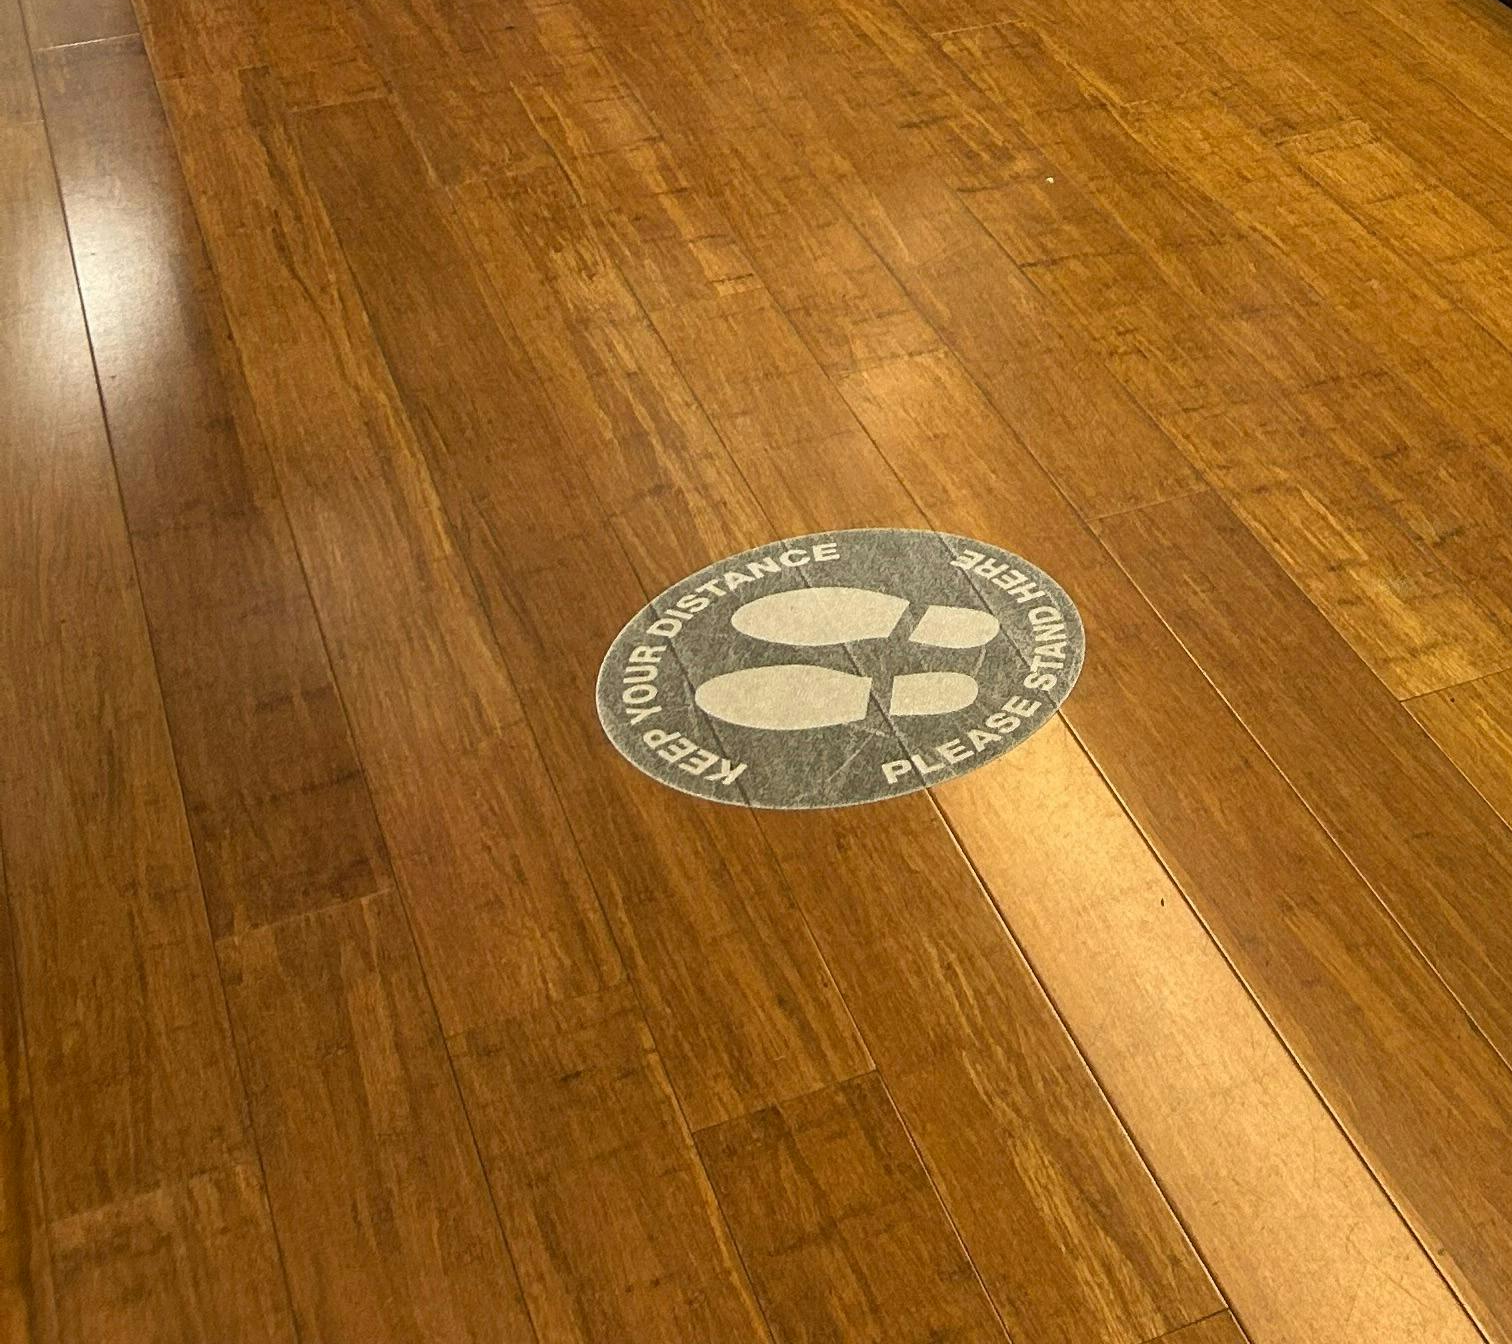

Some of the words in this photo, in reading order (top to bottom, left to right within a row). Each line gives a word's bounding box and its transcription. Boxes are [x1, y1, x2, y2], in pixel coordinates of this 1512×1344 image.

[647, 541, 842, 640] DISTANCE
[949, 547, 1050, 606] HERE
[624, 643, 668, 724] YOUR
[1023, 603, 1069, 693] STAND
[642, 725, 750, 787] KEEP
[881, 694, 1044, 786] PLEASE
